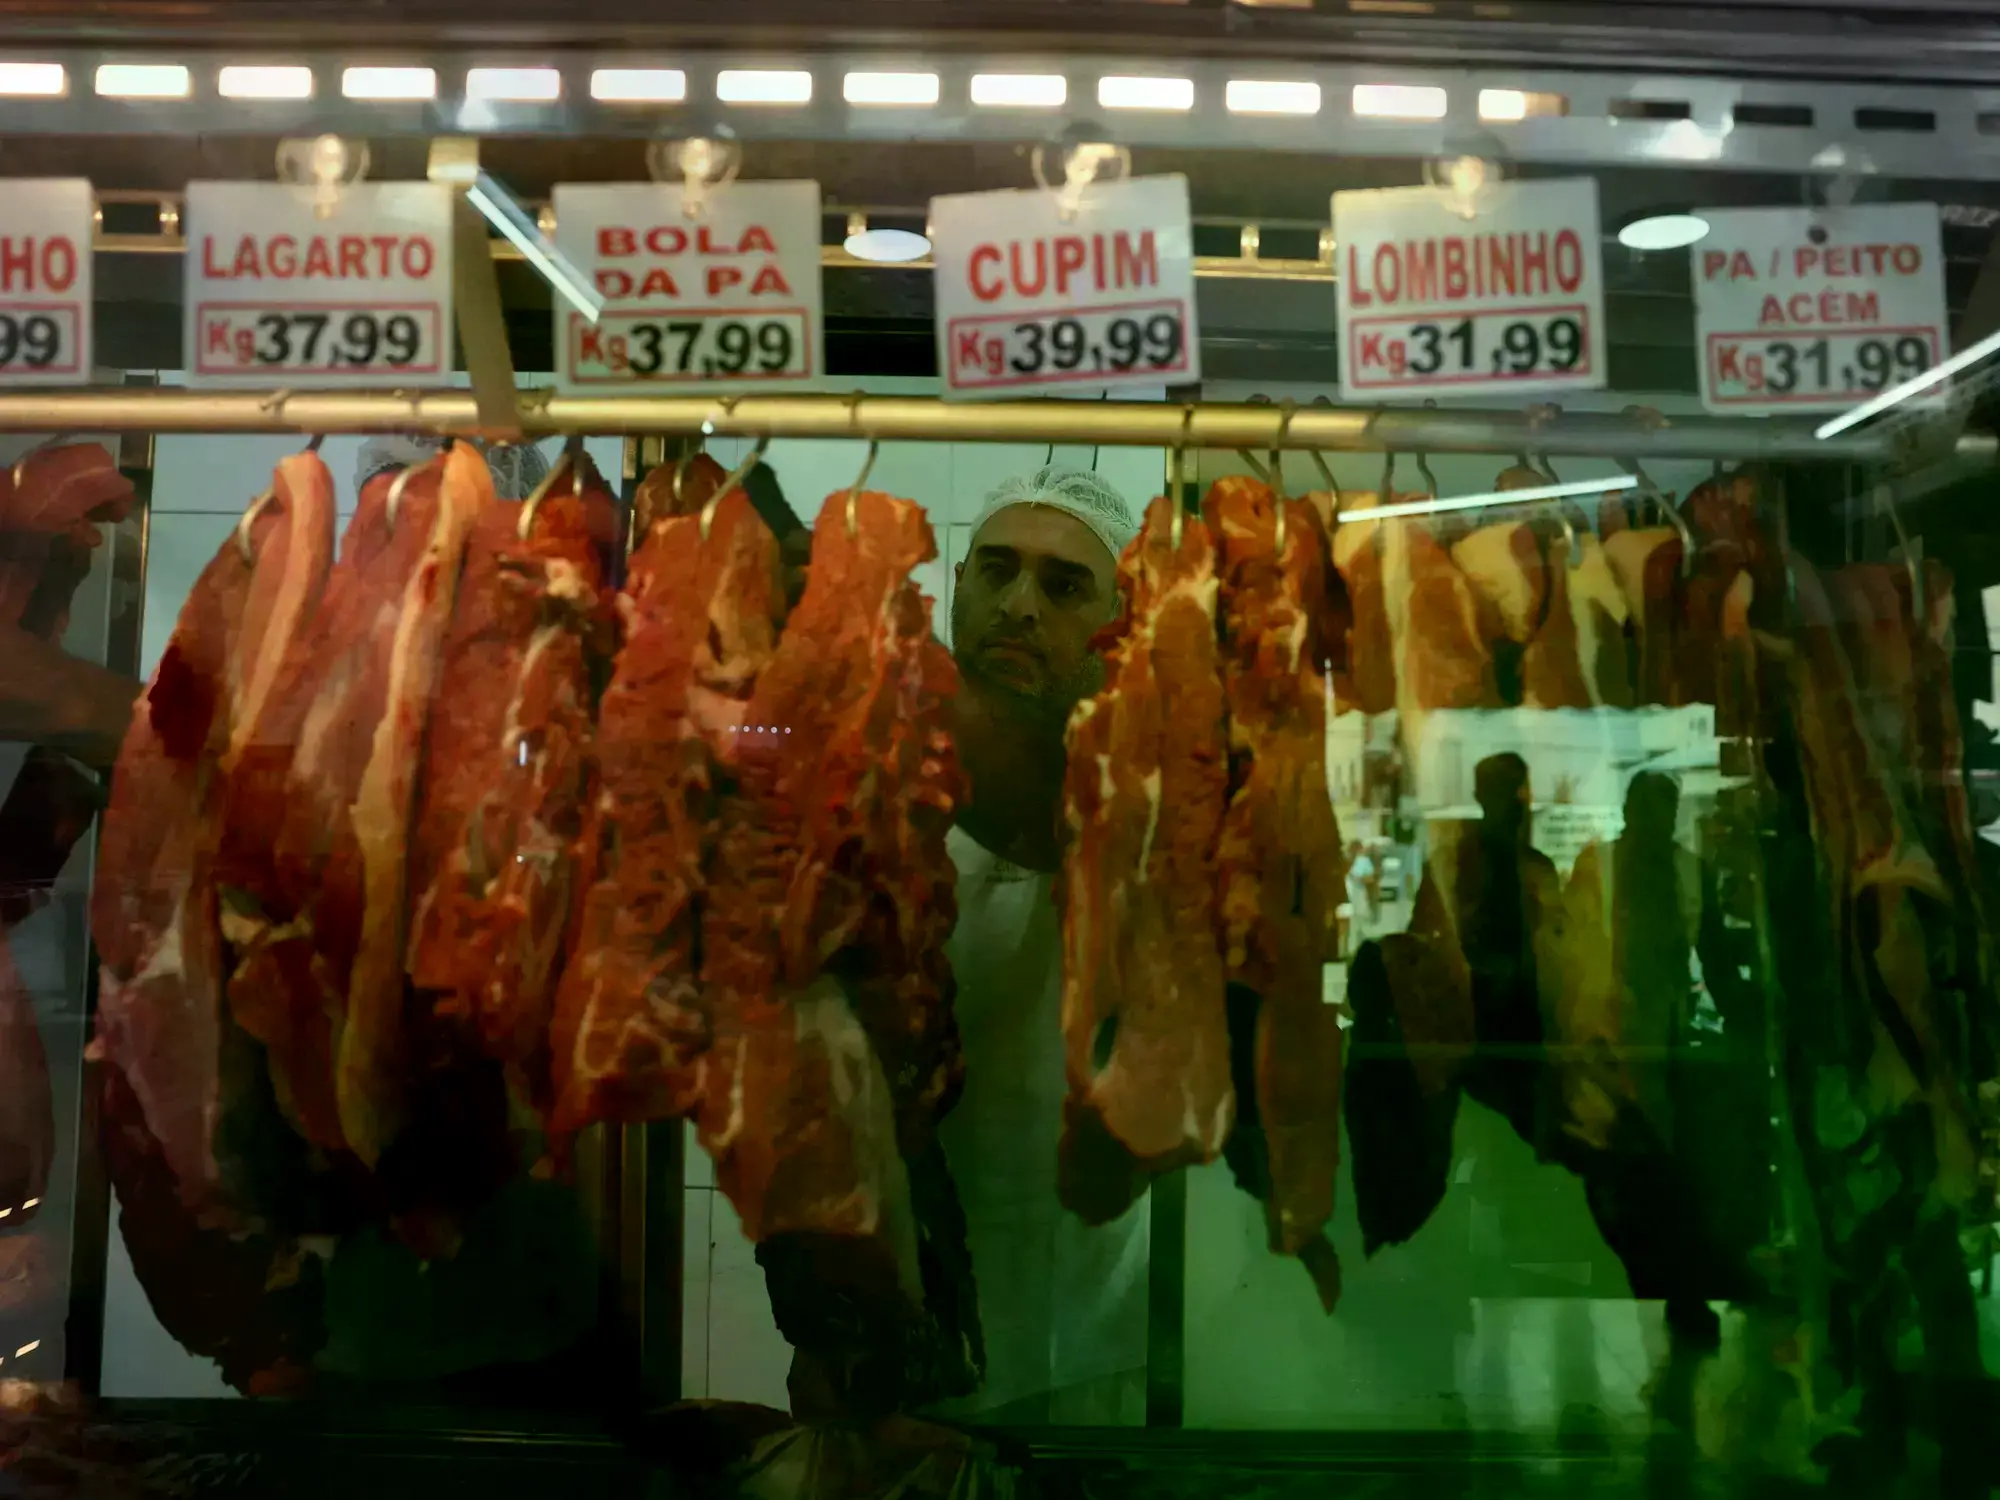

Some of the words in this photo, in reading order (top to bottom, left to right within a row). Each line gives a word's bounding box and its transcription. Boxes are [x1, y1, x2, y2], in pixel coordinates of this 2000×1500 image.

[203, 234, 436, 279] LAGARTO
[597, 225, 778, 256] BOLA
[966, 230, 1159, 302] CUPIM
[1348, 228, 1585, 306] LOMBINHO
[1704, 250, 1756, 281] PA
[1795, 244, 1922, 280] PEITO
[594, 269, 681, 298] DA
[207, 318, 255, 365] Kg
[256, 313, 420, 368] 37,99
[579, 326, 629, 374] Kg
[629, 321, 793, 378] 37,99
[958, 330, 1006, 375] Kg
[1010, 314, 1182, 374] 39,99
[1359, 333, 1407, 376] Kg
[1408, 316, 1584, 376] 31,99
[1718, 345, 1765, 391] Kg
[1766, 336, 1931, 394] 31,99
